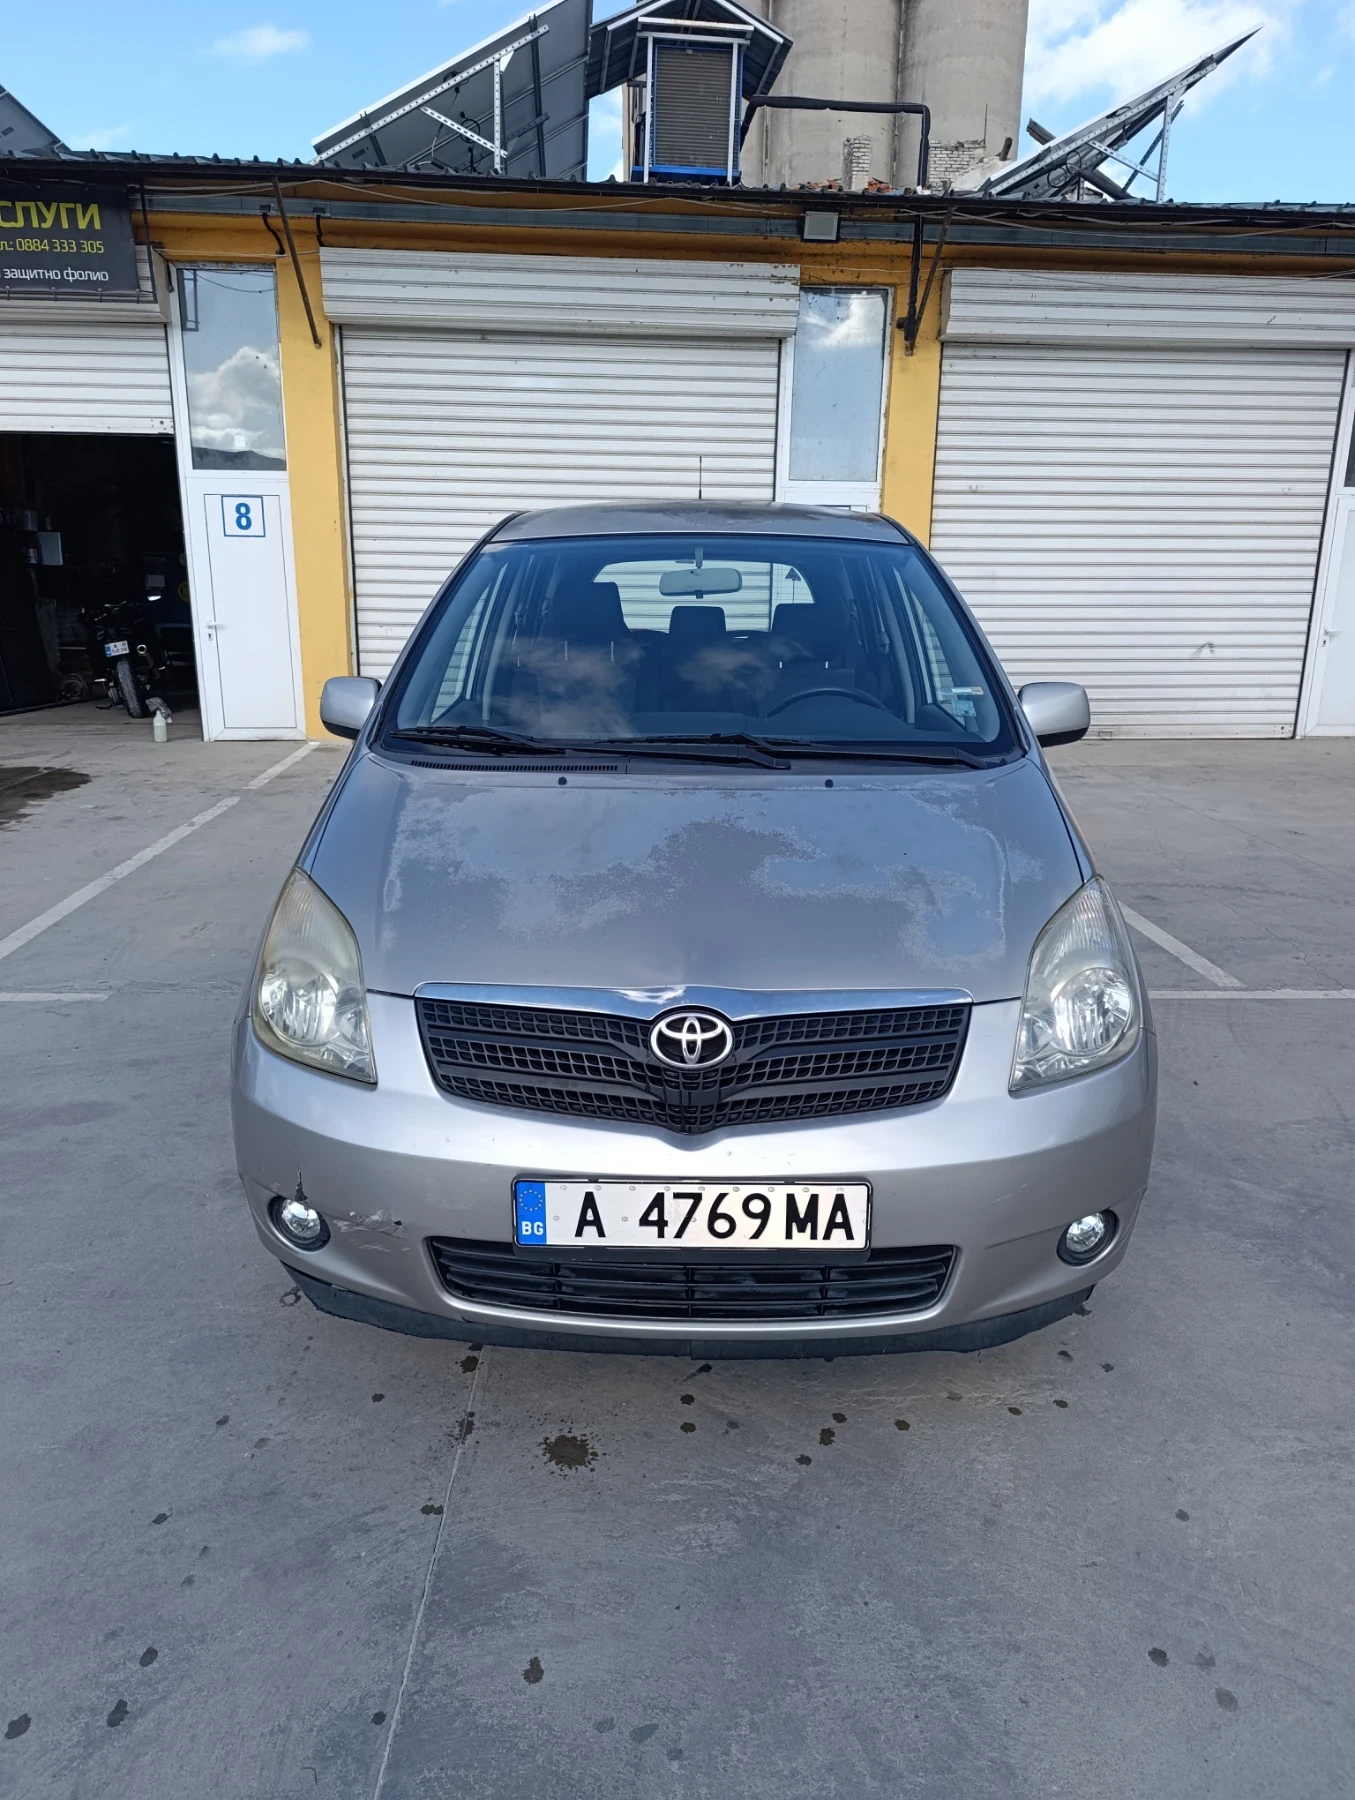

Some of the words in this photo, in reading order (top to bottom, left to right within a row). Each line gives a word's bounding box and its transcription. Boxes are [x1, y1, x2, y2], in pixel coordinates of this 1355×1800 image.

[16, 239, 49, 251] 0884
[52, 240, 76, 252] 333
[80, 241, 104, 253] 305
[3, 268, 61, 280] защитно
[63, 267, 109, 282] фолио
[235, 502, 252, 530] 8
[522, 1222, 544, 1236] BG
[575, 1191, 606, 1238] A
[639, 1192, 771, 1240] 4769
[785, 1193, 855, 1241] MA
